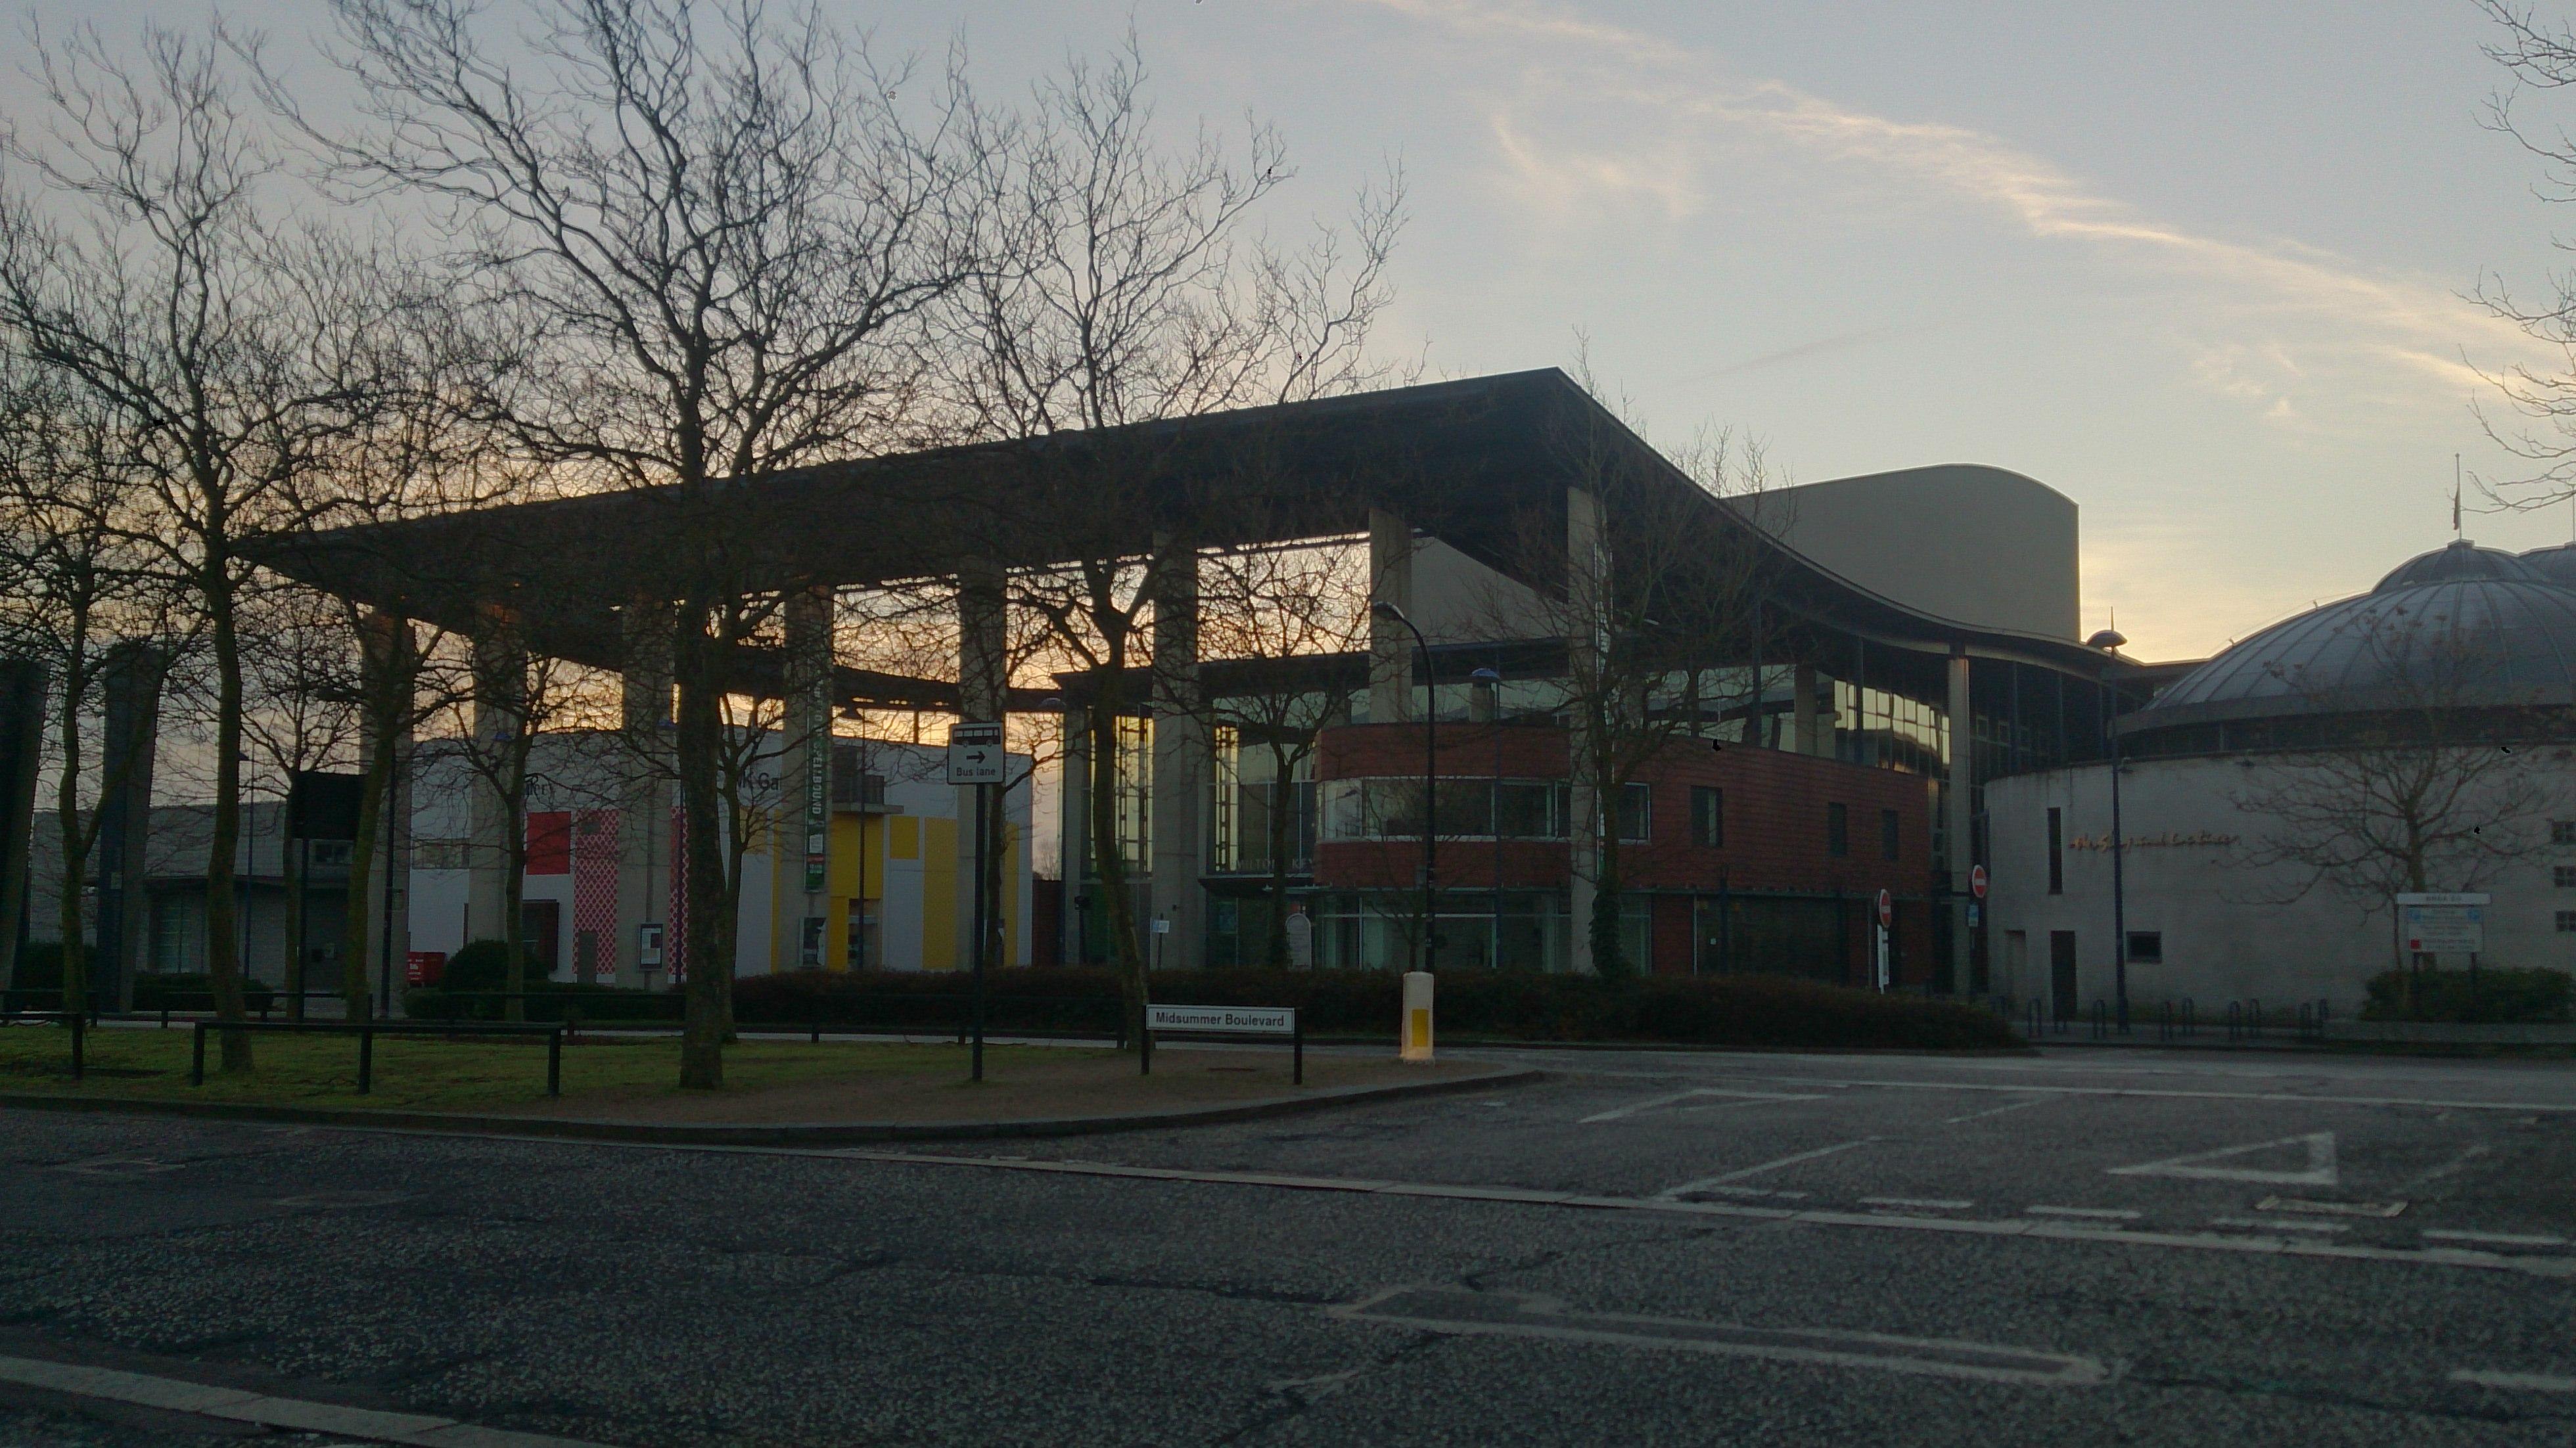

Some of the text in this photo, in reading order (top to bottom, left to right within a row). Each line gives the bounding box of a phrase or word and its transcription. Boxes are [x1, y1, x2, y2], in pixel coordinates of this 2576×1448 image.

[956, 766, 996, 777] Bus lane
[1156, 1012, 1285, 1026] Midsummer Boulevard
